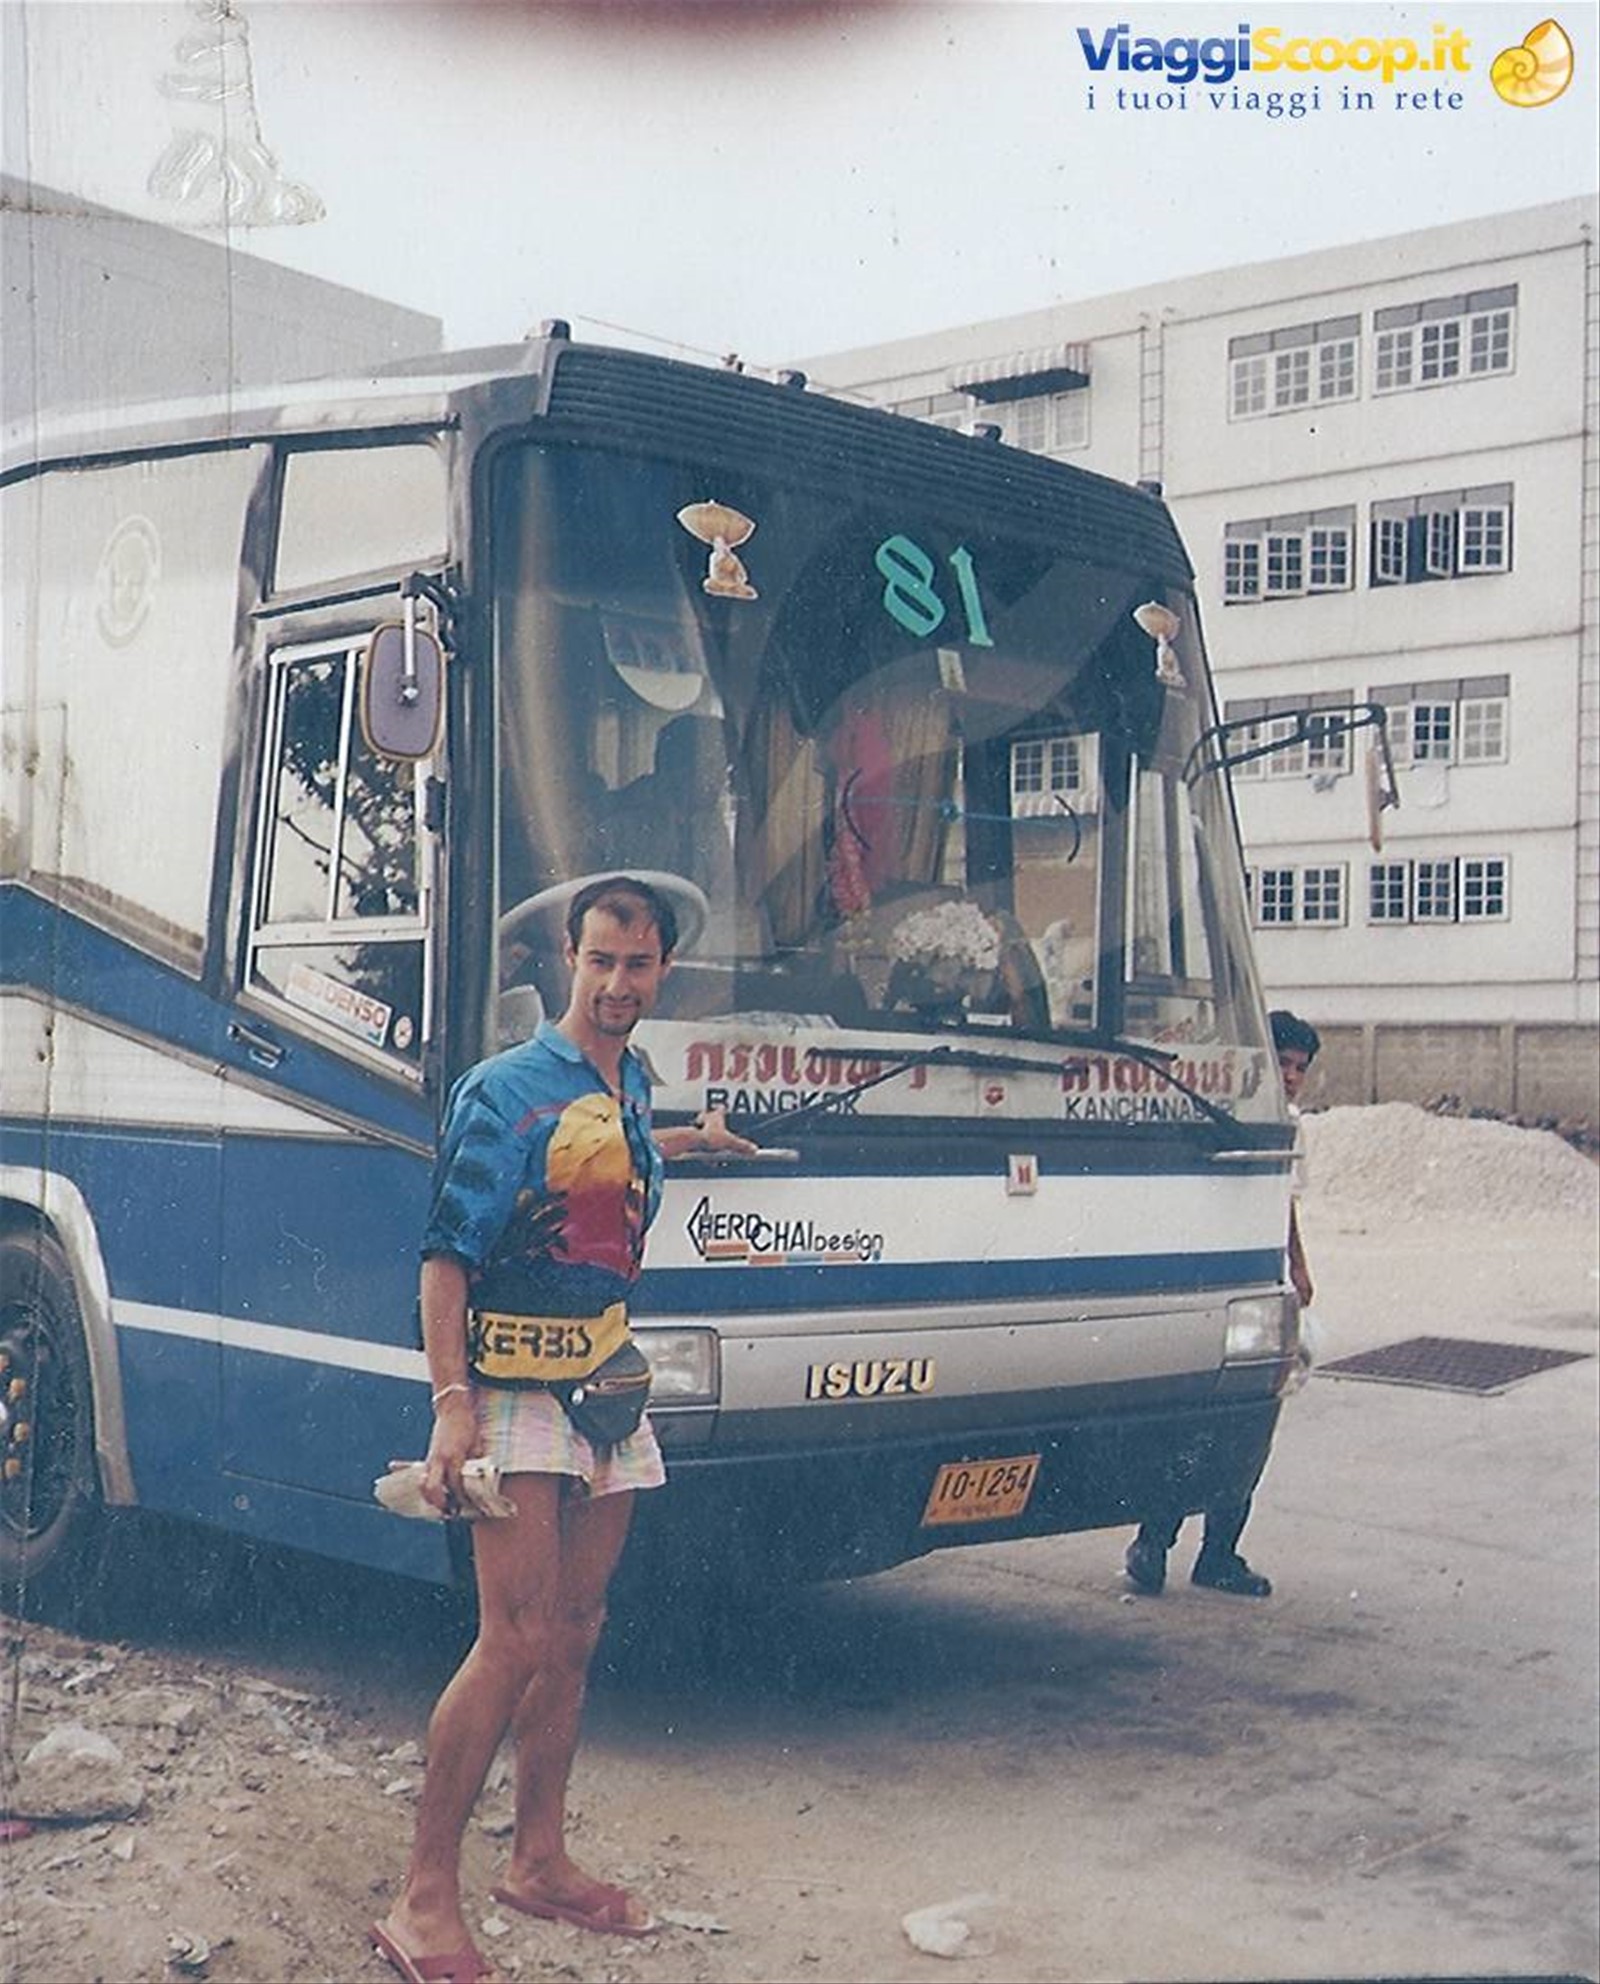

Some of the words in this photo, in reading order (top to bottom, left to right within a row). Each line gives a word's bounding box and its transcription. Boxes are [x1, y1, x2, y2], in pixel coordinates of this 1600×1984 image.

[875, 534, 995, 647] 81
[1065, 1097, 1237, 1121] KANCHANABR
[806, 1357, 936, 1399] ISUZU
[939, 1463, 1033, 1502] 10-1254
